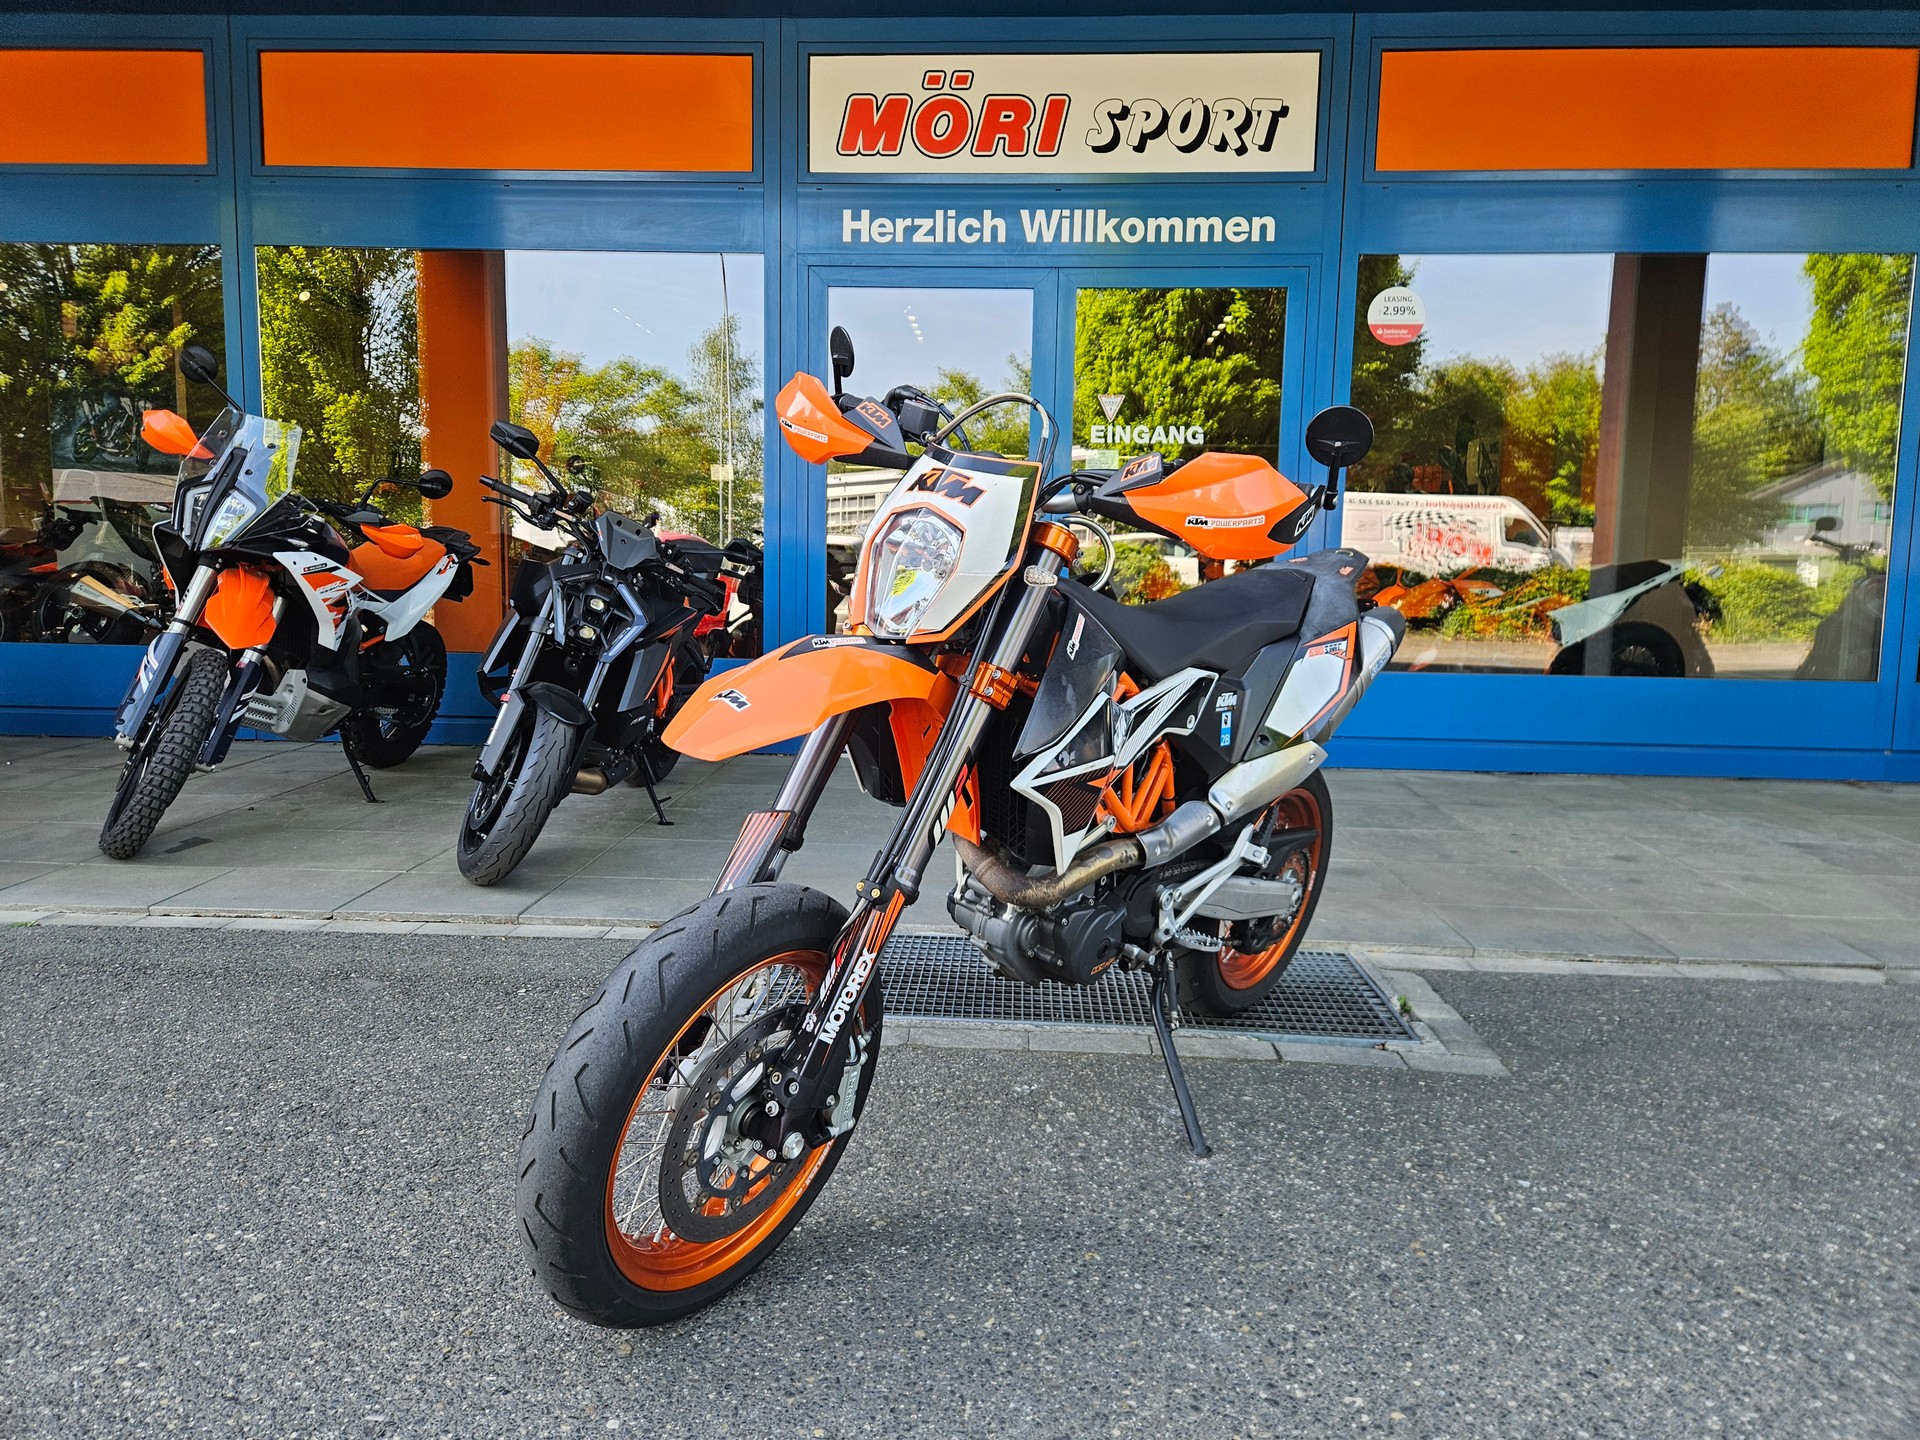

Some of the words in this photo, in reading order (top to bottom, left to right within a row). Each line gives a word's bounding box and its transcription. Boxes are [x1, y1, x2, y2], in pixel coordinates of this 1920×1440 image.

[836, 70, 1071, 158] MÖRI
[1085, 97, 1290, 156] SPORT
[842, 209, 1006, 243] Herzlich
[1021, 209, 1276, 243] Willkommen
[1383, 295, 1413, 303] LEASING
[1383, 306, 1416, 316] 2.99%
[857, 401, 892, 428] KTM
[793, 425, 828, 442] POWERPARTS
[1090, 425, 1205, 445] EINGANG
[1121, 455, 1160, 481] KTM
[905, 467, 988, 508] KTM
[1187, 517, 1209, 526] KTM
[1211, 516, 1264, 527] POWERPARTS
[813, 638, 830, 646] KTM
[712, 690, 749, 710] KTM
[1215, 692, 1237, 707] KTM
[818, 947, 877, 1044] MOTOREX
